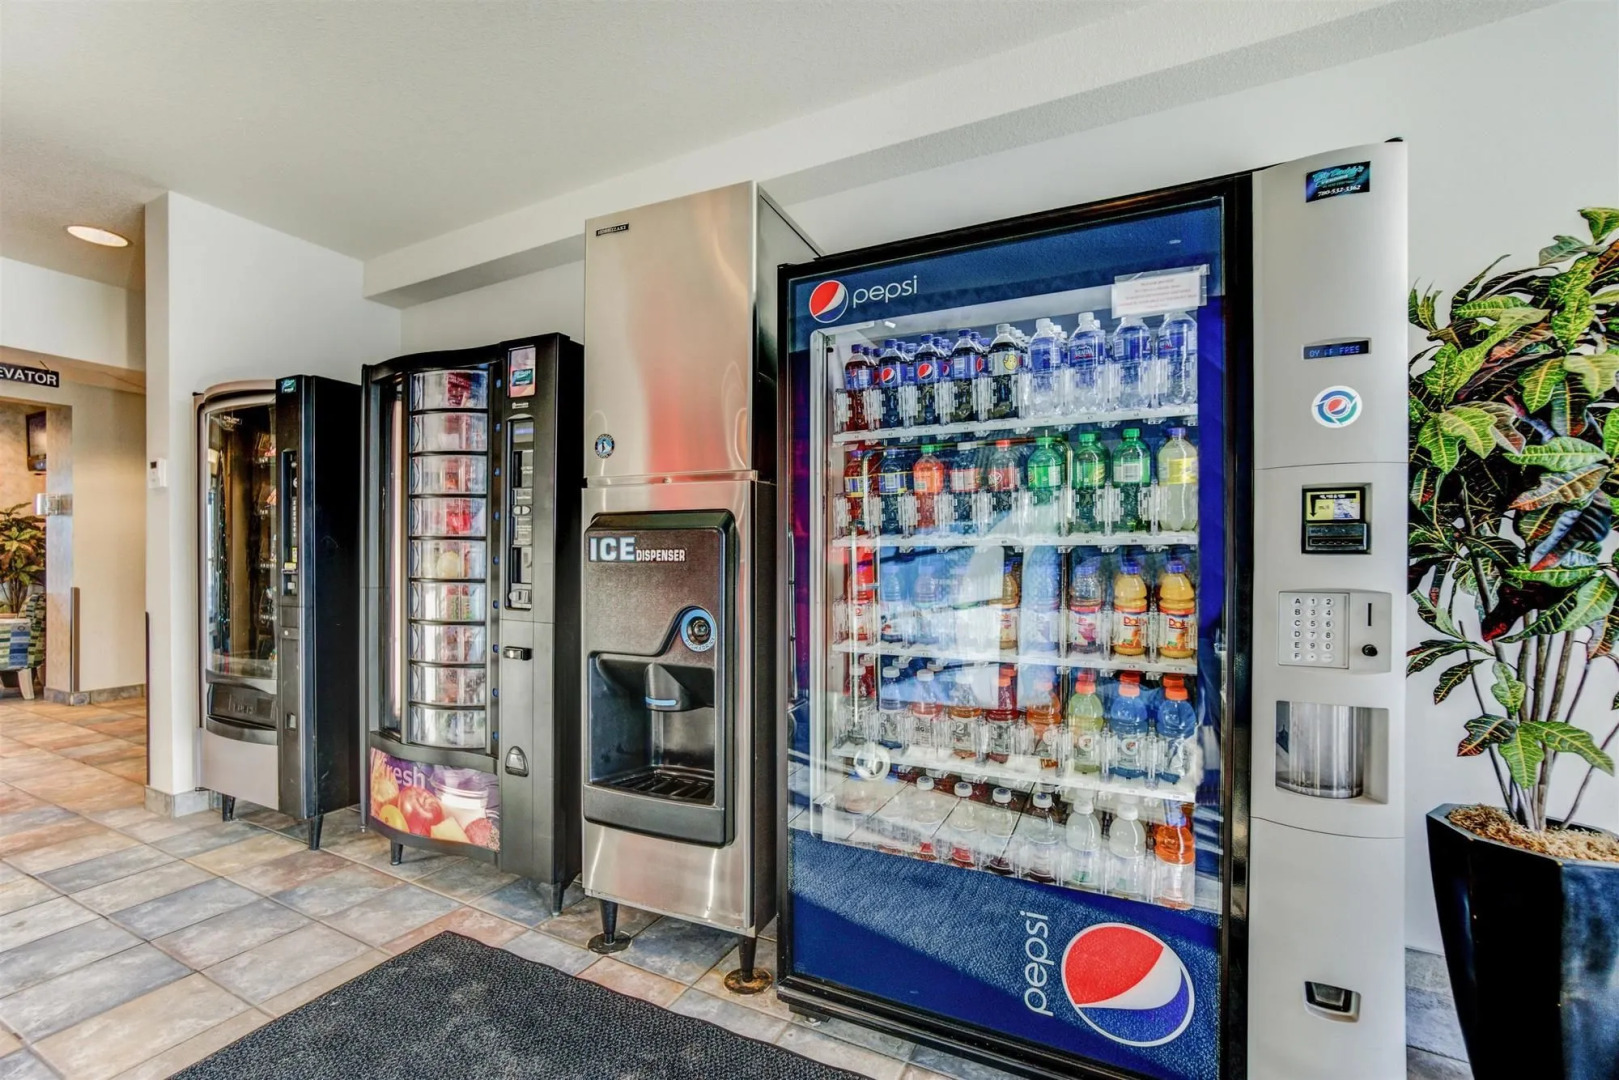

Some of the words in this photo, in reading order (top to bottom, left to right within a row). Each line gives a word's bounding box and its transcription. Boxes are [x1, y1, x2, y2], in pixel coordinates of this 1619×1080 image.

[853, 275, 917, 309] pepsi
[590, 536, 635, 561] ICE
[636, 549, 686, 562] DISPENSER
[1325, 598, 1332, 606] 2
[1294, 608, 1301, 616] B
[1294, 619, 1301, 627] C
[1325, 620, 1331, 628] 6
[1294, 630, 1301, 638] D
[1325, 631, 1331, 639] 8
[1294, 641, 1301, 649] E
[1294, 652, 1301, 660] F
[382, 757, 425, 789] fresh
[1024, 910, 1055, 1017] pepsi
